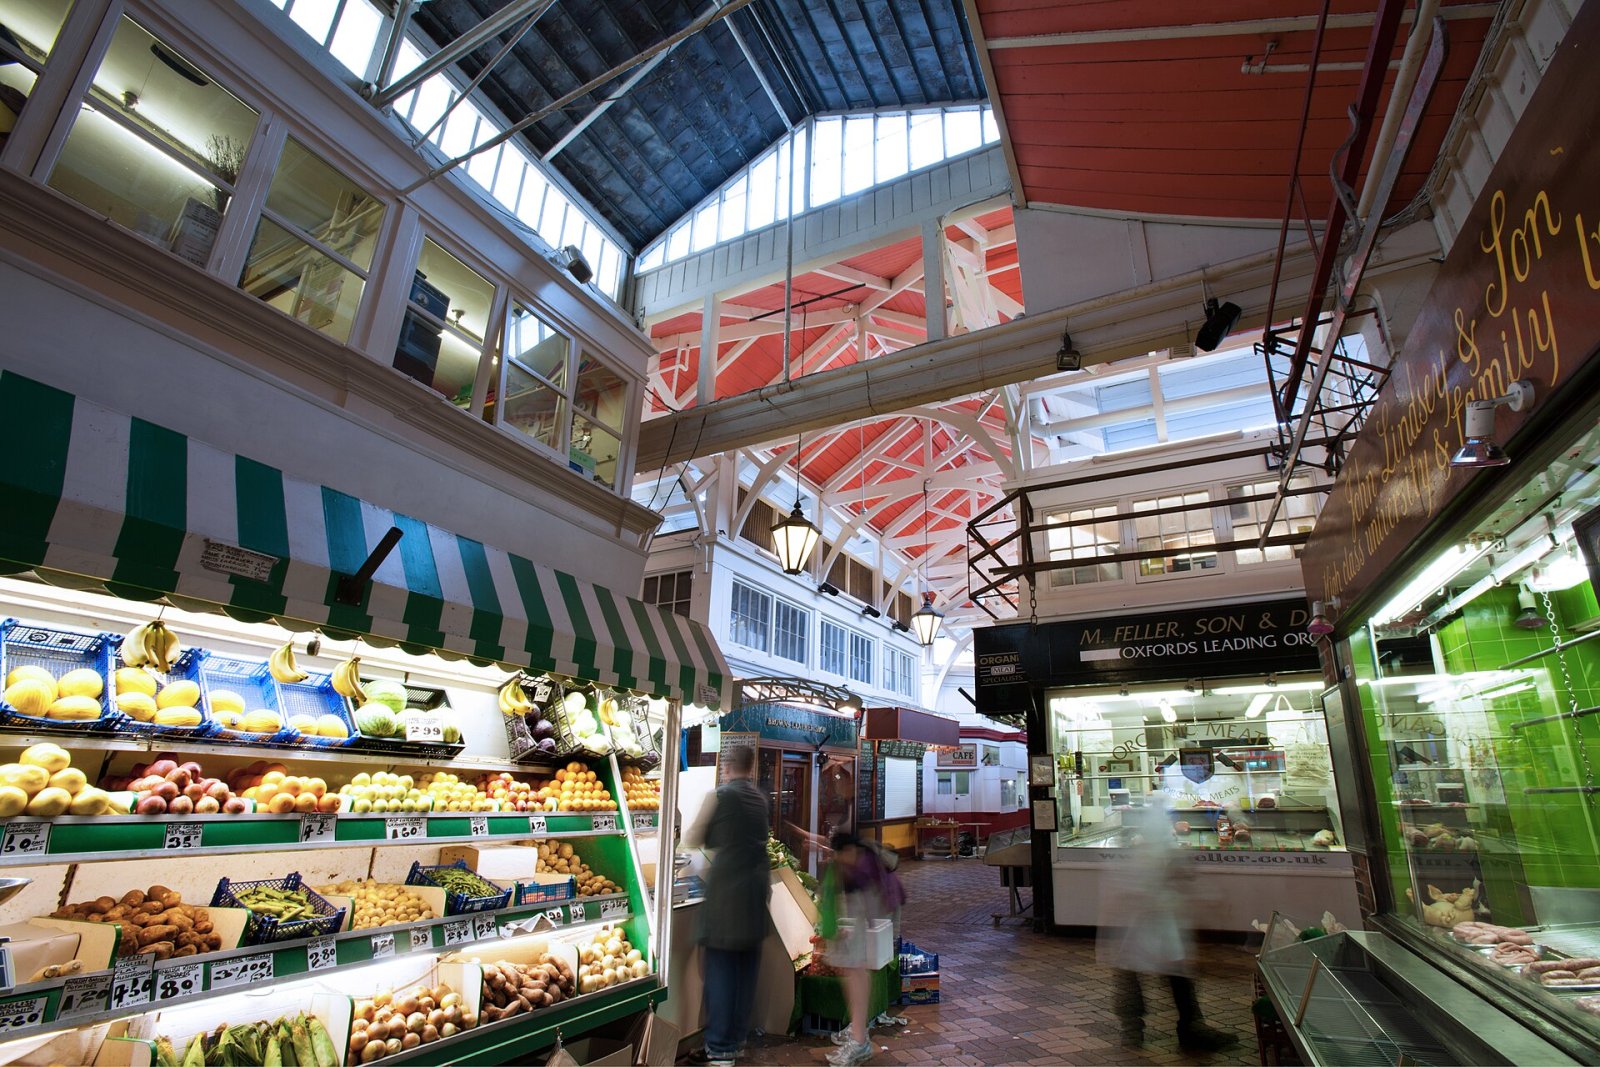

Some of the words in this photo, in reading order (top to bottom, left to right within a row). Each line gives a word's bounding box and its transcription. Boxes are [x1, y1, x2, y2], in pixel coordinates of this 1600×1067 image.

[1345, 458, 1378, 544] John
[1376, 350, 1450, 484] Lindsey
[1455, 307, 1480, 377] &
[1480, 190, 1562, 317] Son
[1342, 539, 1365, 585] class
[1365, 449, 1432, 556] university
[1434, 428, 1451, 481] &
[1080, 628, 1105, 645] M.
[1114, 621, 1185, 642] FELLER,
[1193, 615, 1245, 635] SON
[1258, 612, 1278, 629] &
[1289, 609, 1312, 627] D
[1122, 641, 1198, 659] OXFORDS
[1203, 634, 1277, 653] LEADING
[982, 674, 1024, 684] SPECIALISTS
[1206, 722, 1279, 751] MEATS
[1209, 785, 1240, 800] MEATS
